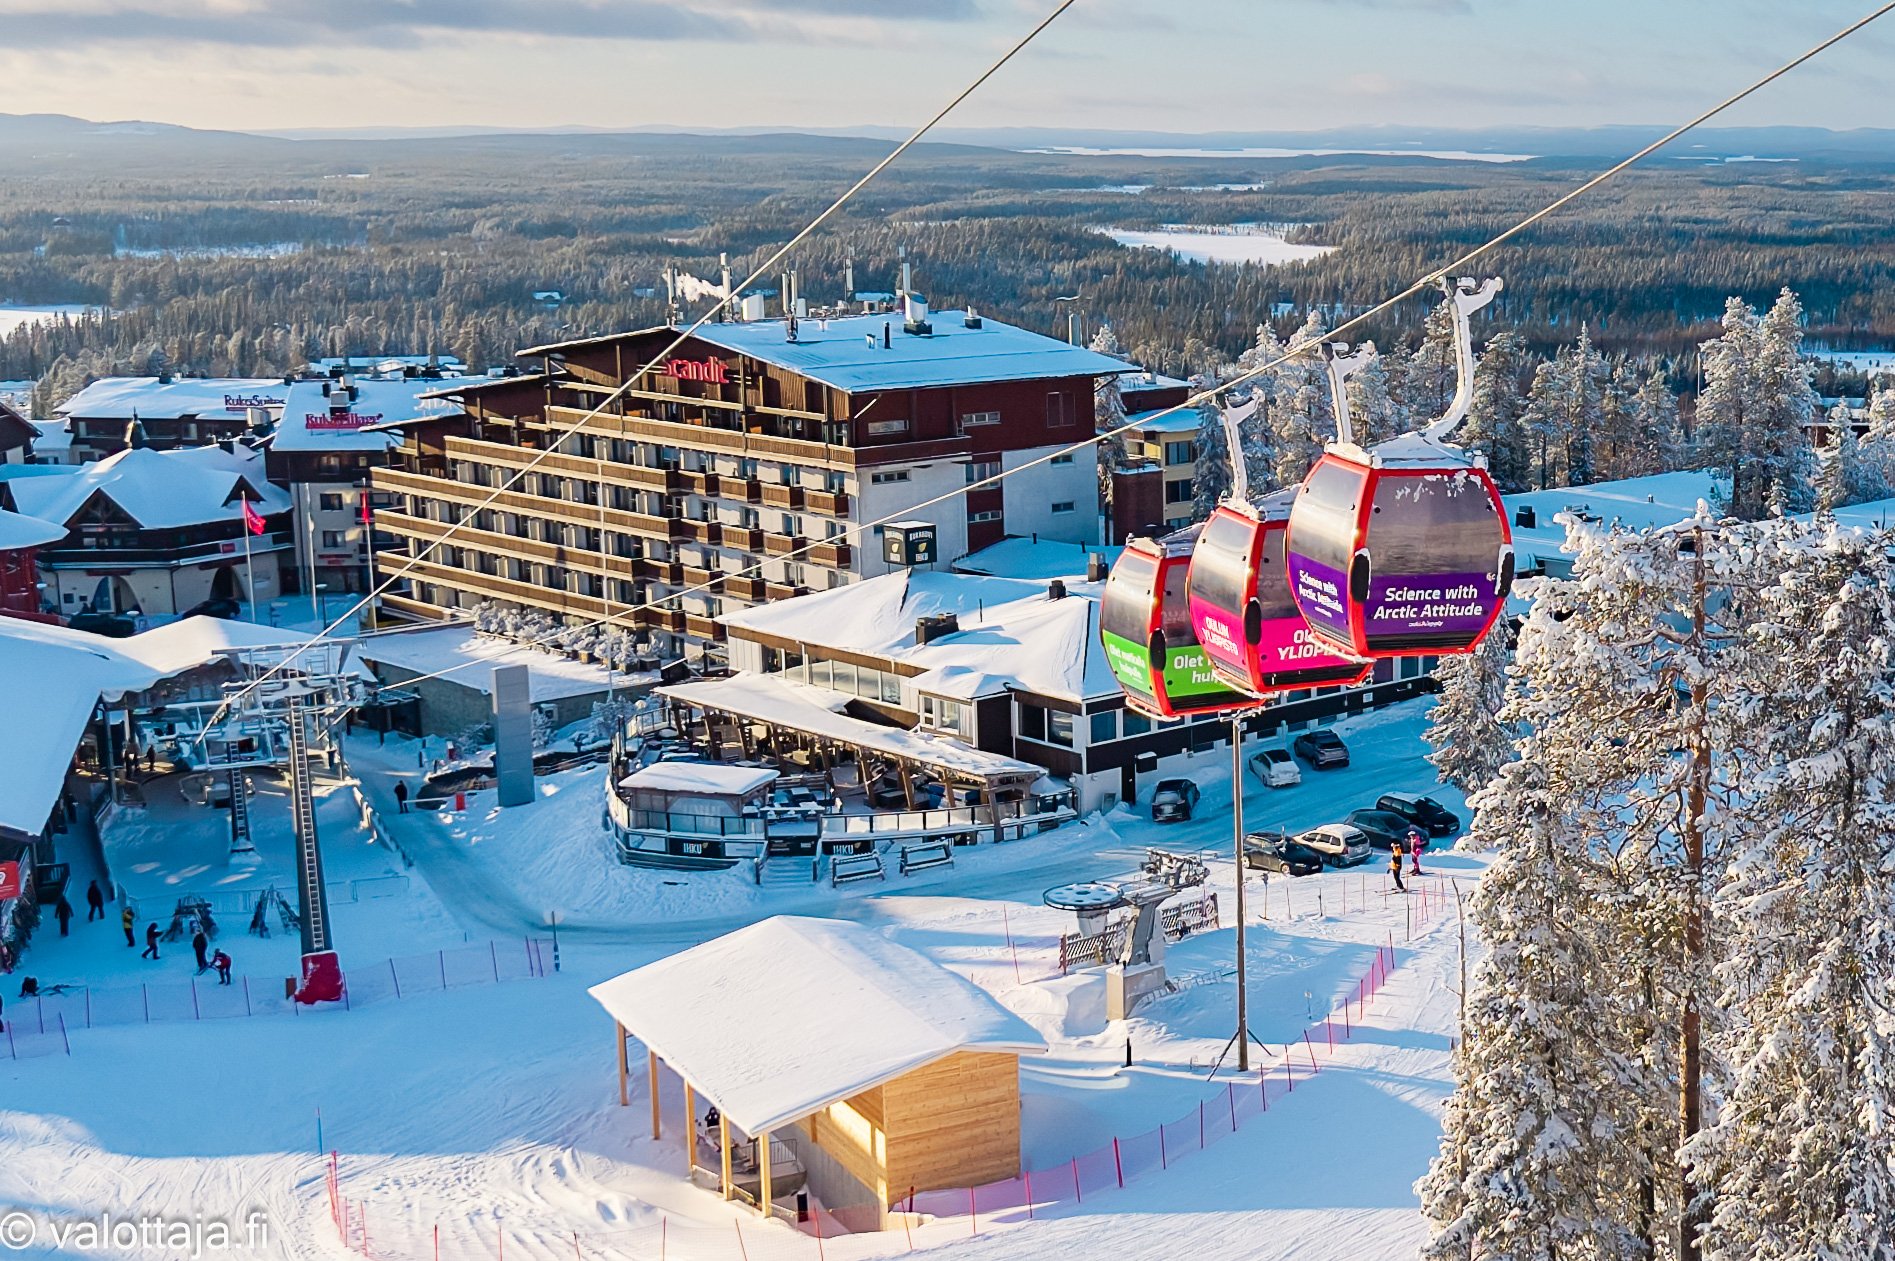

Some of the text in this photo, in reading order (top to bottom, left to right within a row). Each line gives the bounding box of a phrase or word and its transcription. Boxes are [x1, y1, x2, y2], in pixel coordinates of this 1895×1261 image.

[1384, 584, 1478, 602] Science with
[1373, 602, 1483, 620] Arctic Attitude
[1174, 655, 1204, 669] Olet
[833, 844, 854, 855] IHKU
